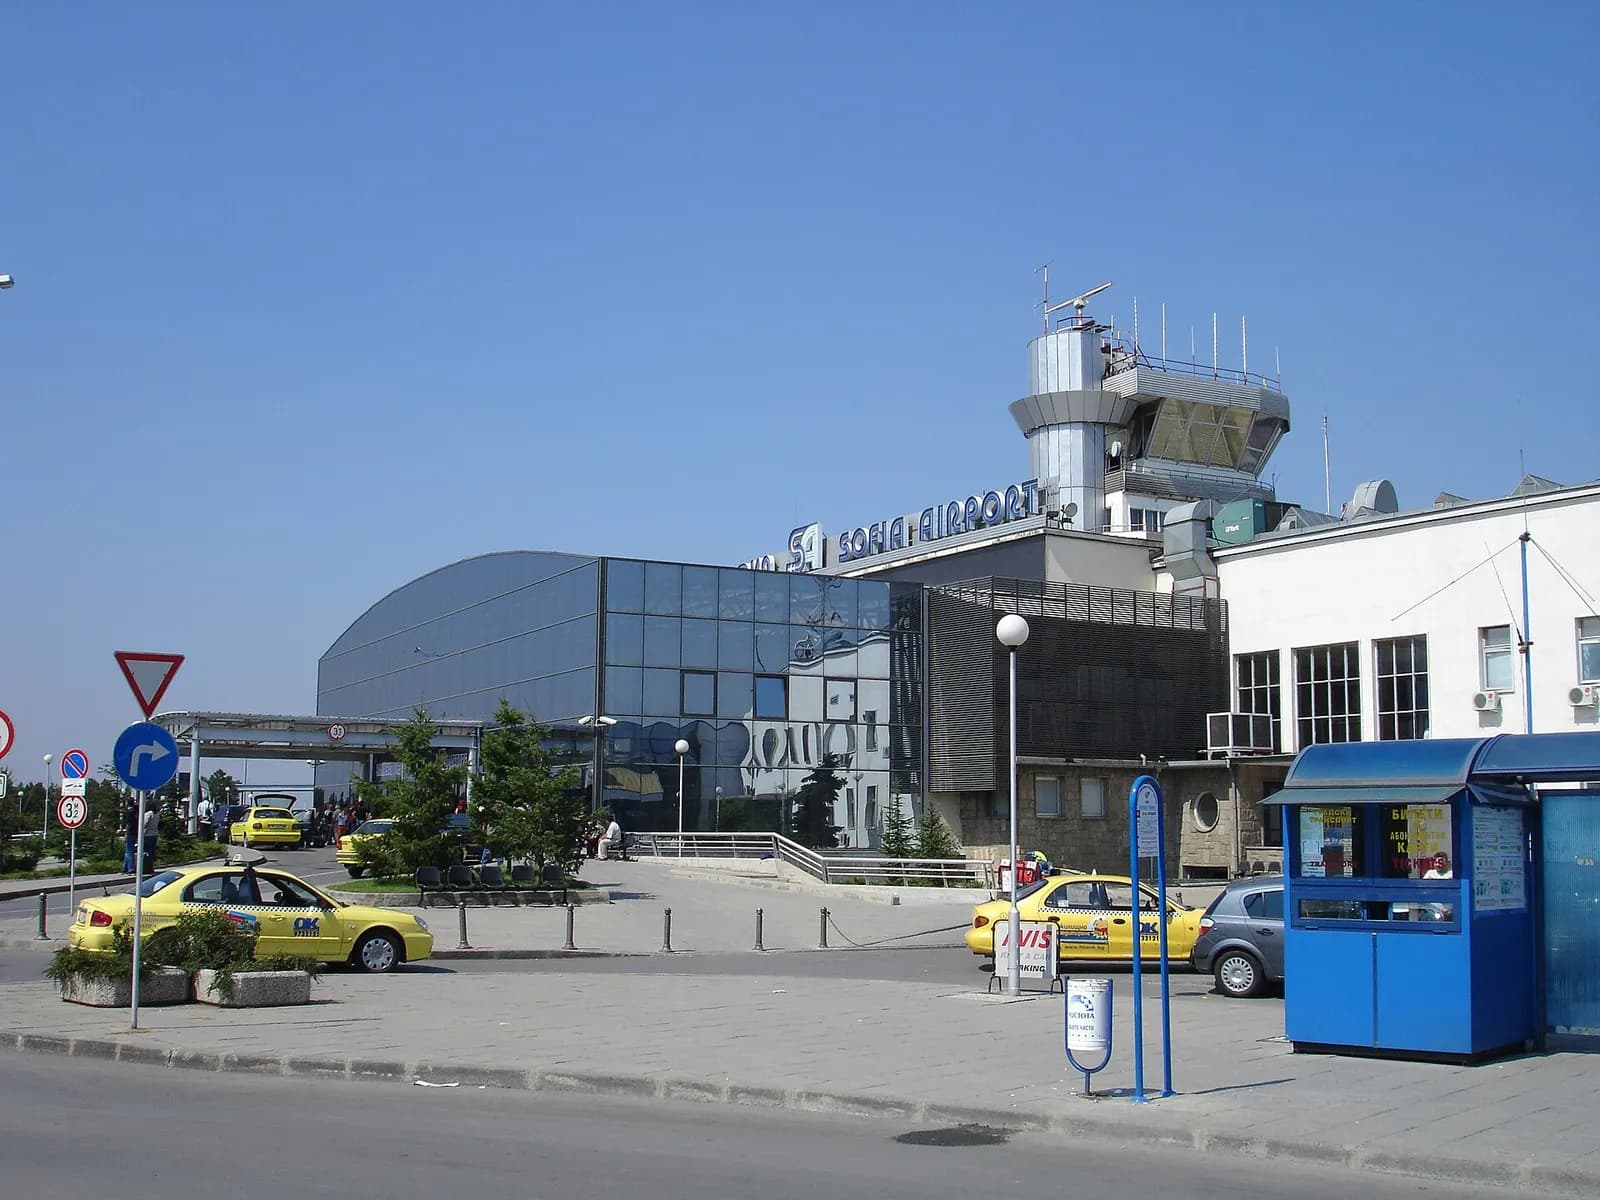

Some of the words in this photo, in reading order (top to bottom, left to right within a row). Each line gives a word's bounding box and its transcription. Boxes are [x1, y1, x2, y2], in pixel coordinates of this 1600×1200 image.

[838, 516, 905, 562] SOFIA
[919, 478, 1039, 541] AIRPORT
[65, 803, 73, 818] 3
[1392, 809, 1442, 820] БИЛЕТИ
[294, 917, 319, 930] OK
